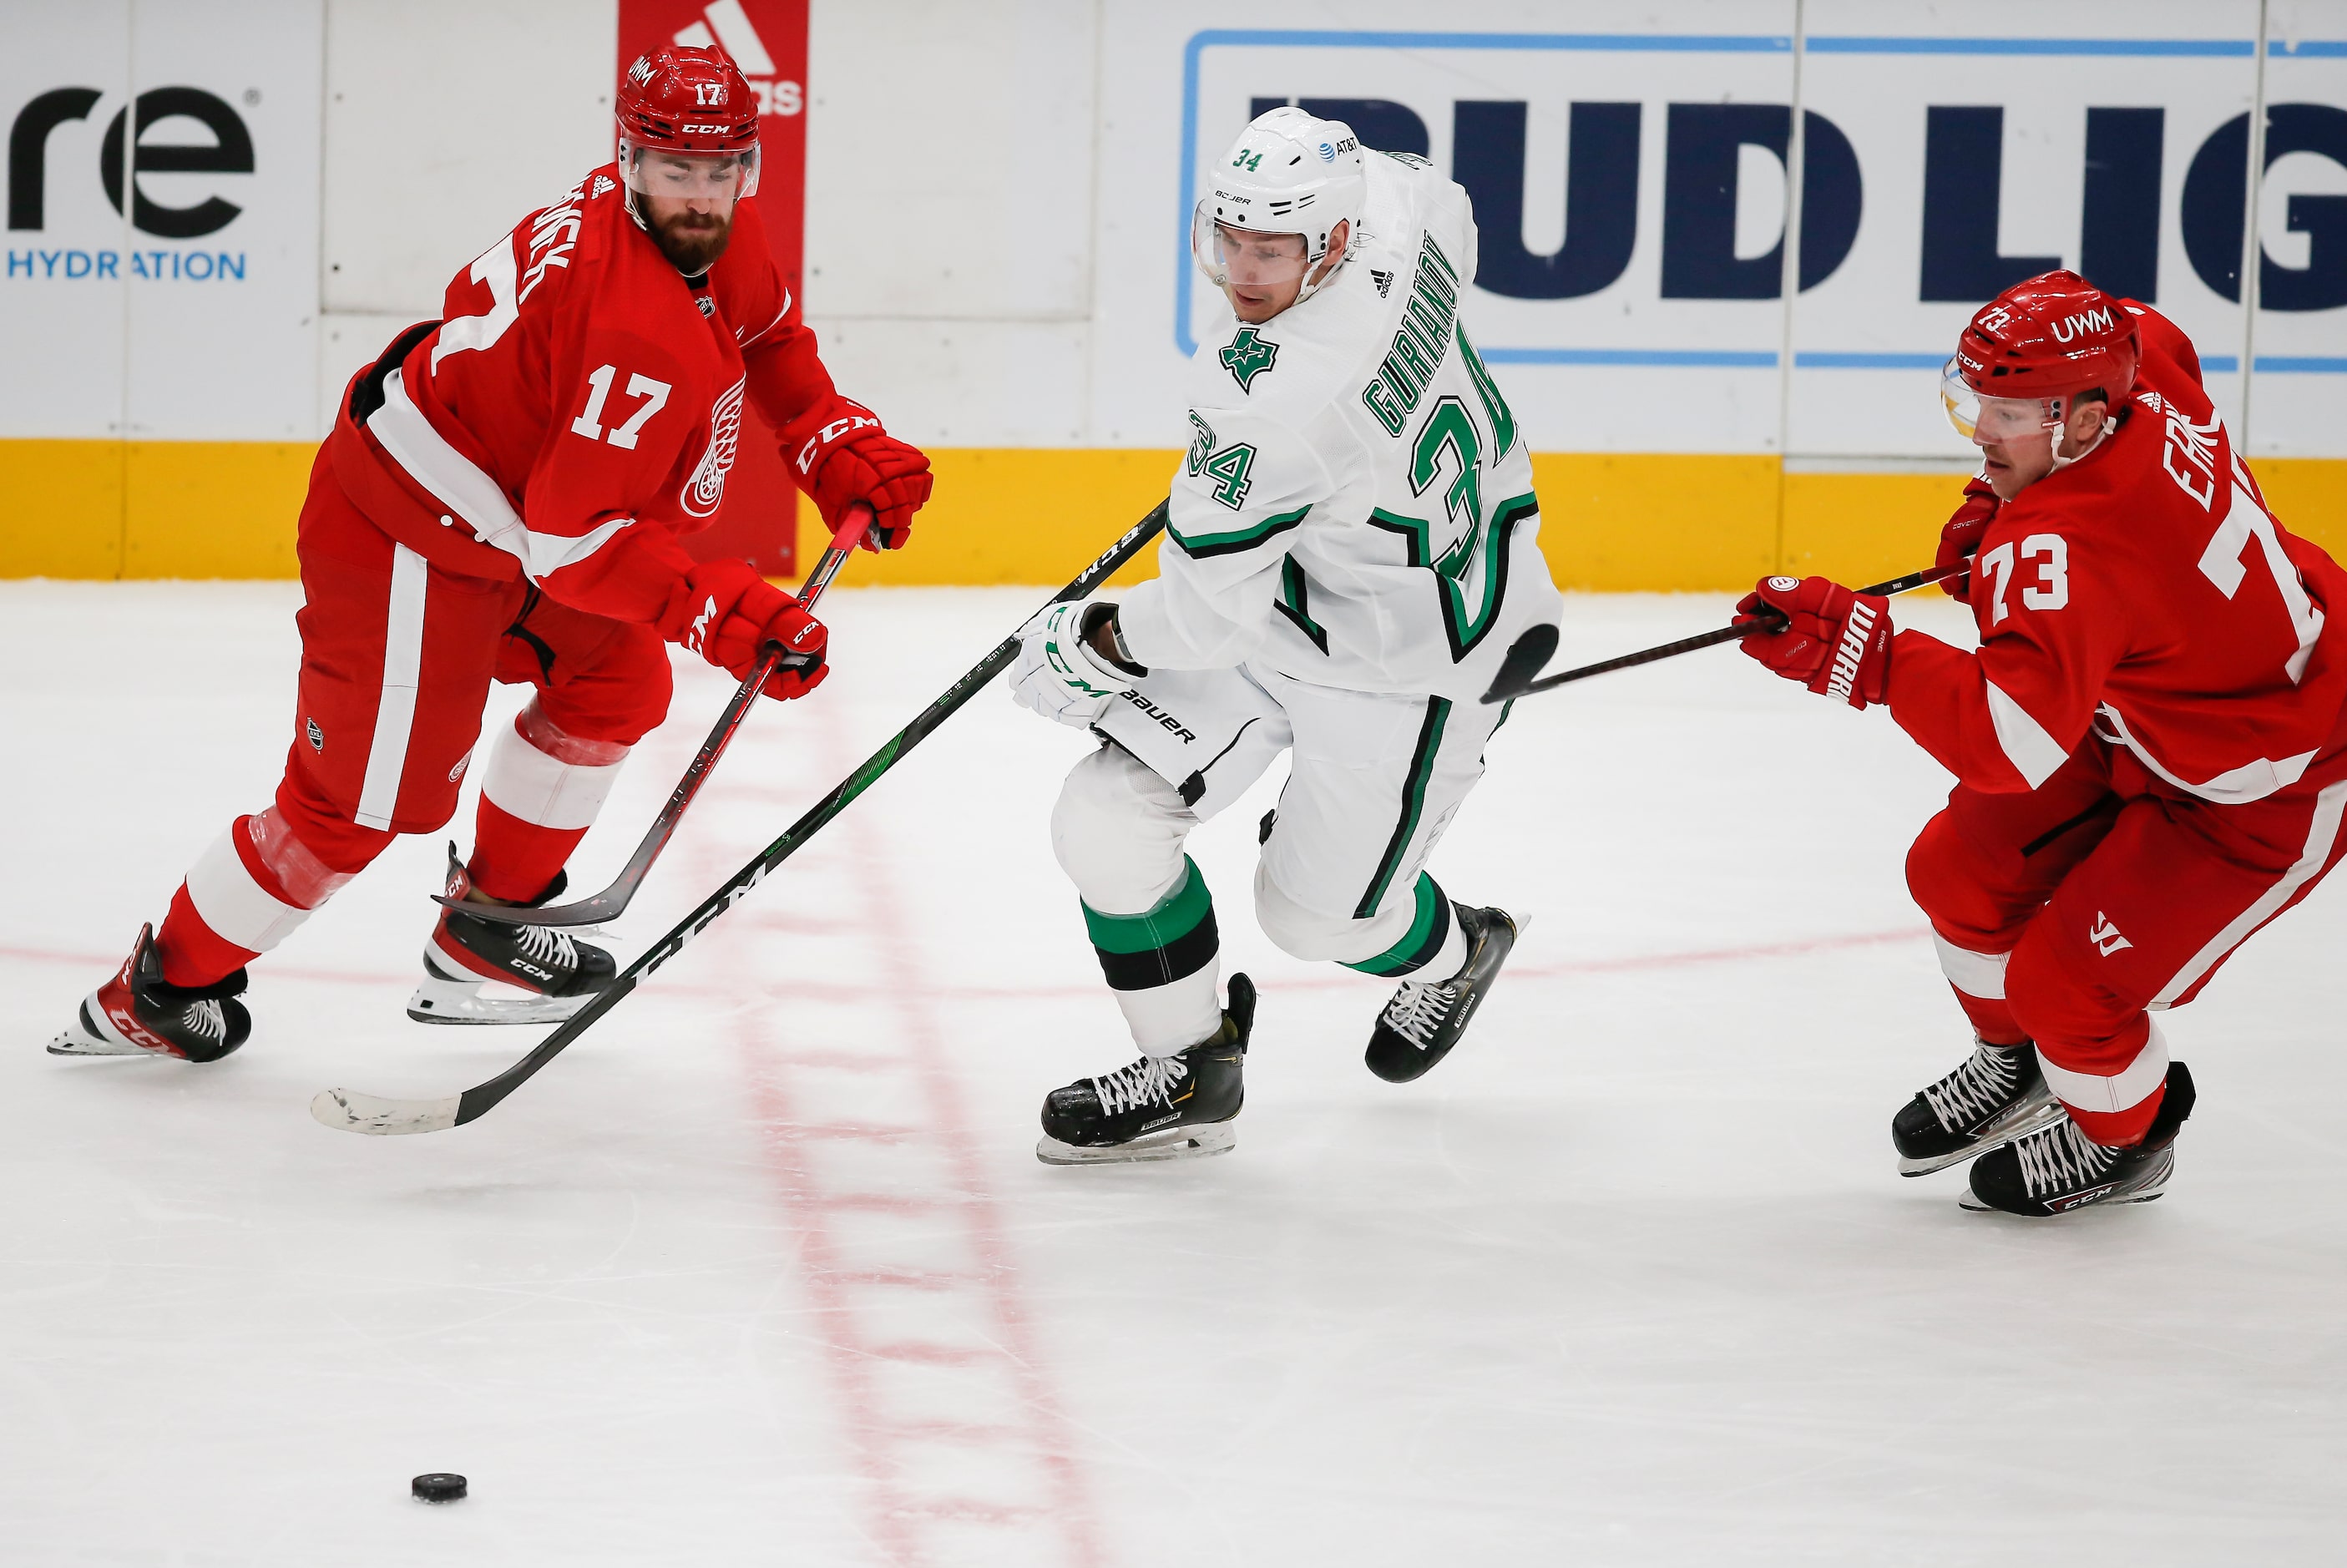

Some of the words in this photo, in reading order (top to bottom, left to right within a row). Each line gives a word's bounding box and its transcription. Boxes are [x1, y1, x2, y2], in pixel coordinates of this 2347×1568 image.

[629, 55, 657, 88] UWM
[694, 83, 722, 106] 17
[681, 124, 731, 134] CCM
[1232, 149, 1263, 173] 34
[1337, 137, 1358, 156] AT&T
[8, 86, 255, 239] re
[591, 175, 603, 200] adidas
[8, 250, 246, 281] HYDRATION
[1380, 271, 1394, 299] adidas
[1362, 229, 1460, 438] GURIANOV
[1978, 306, 2011, 332] 73
[2051, 306, 2115, 343] UWM
[1958, 351, 1985, 372] CCM
[571, 363, 672, 450] 17
[796, 416, 879, 474] CCM
[1187, 408, 1257, 512] 34
[1982, 534, 2069, 627] 73
[1045, 606, 1114, 698] CCM
[1877, 630, 1887, 653] ERNE
[1119, 689, 1196, 745] BAUER
[445, 875, 463, 898] CM
[631, 862, 766, 986] CCM
[510, 959, 554, 981] CCM
[2064, 1186, 2113, 1211] CCM
